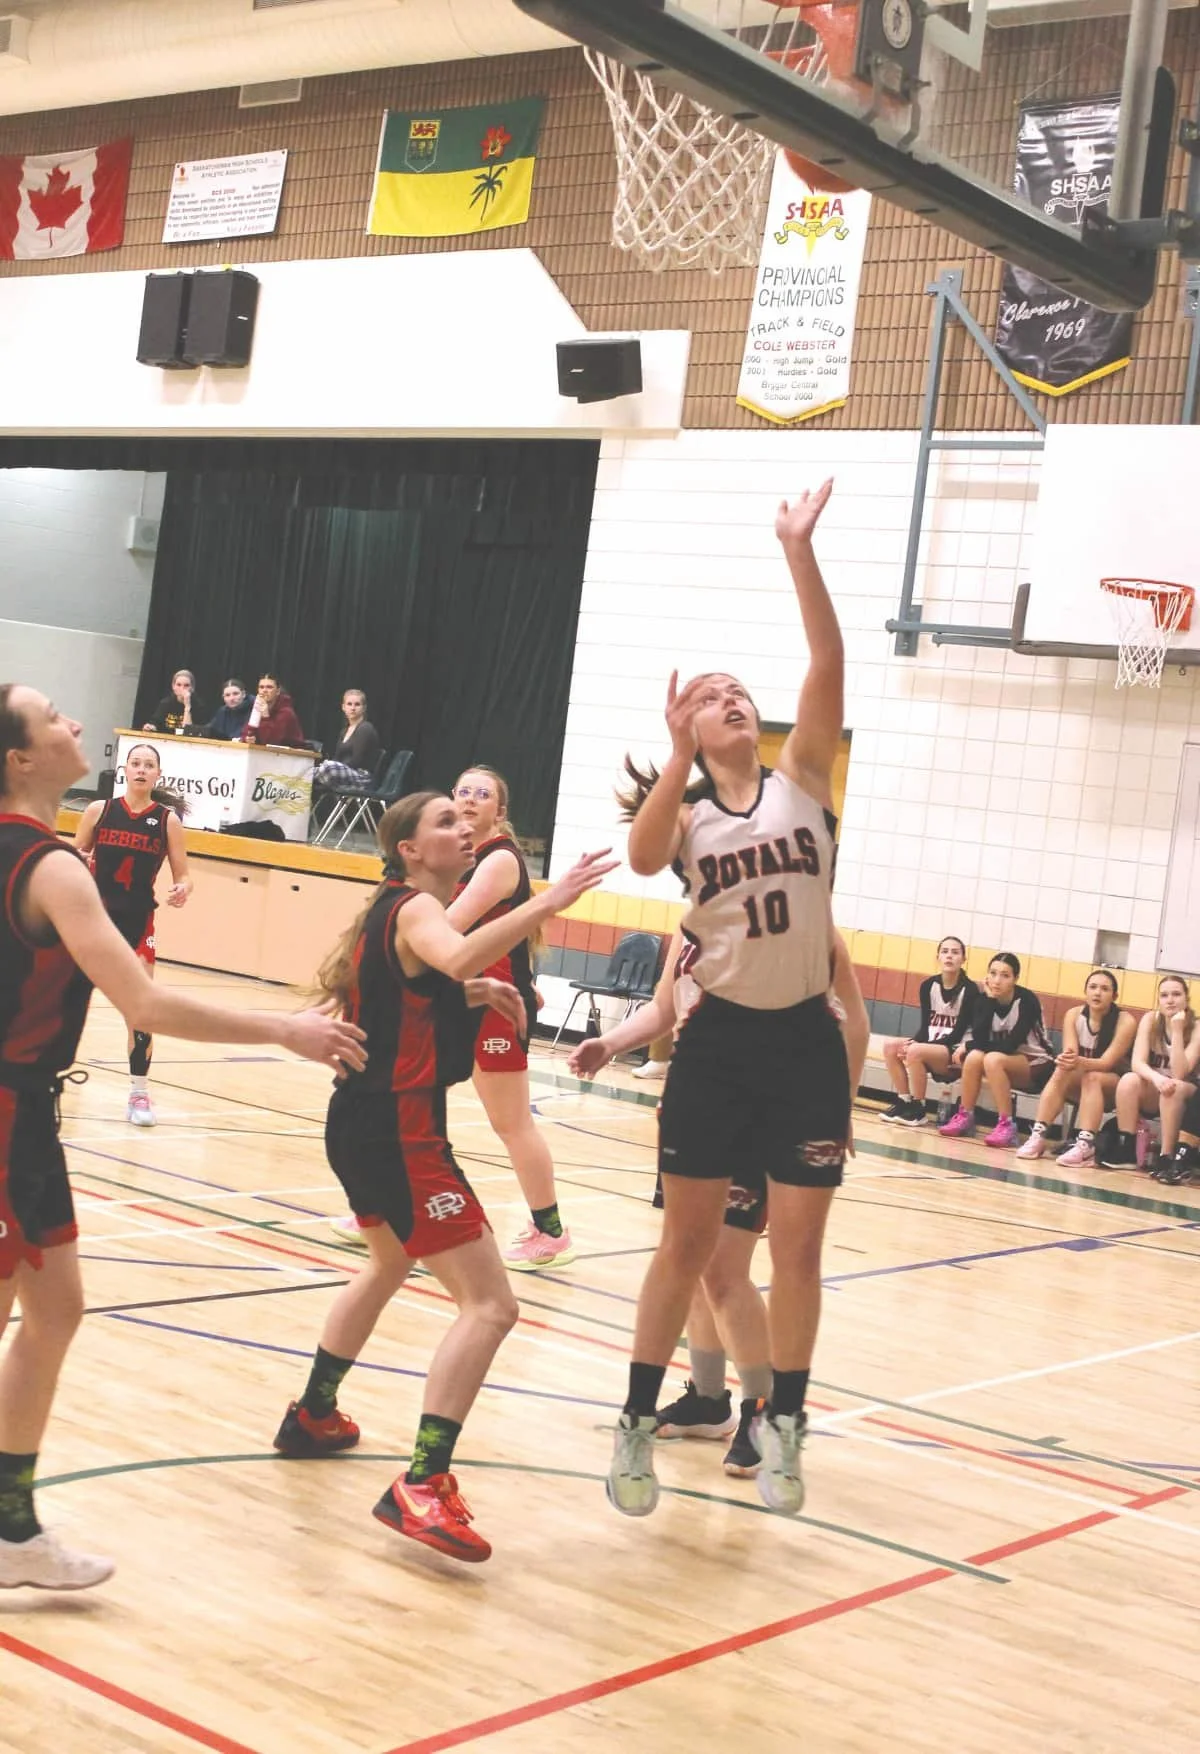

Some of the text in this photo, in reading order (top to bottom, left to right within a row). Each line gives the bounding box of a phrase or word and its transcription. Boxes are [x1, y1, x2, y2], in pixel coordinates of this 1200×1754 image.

[1050, 174, 1112, 196] SHSAA
[785, 198, 844, 220] SHSAA
[762, 265, 846, 286] PROVINCIAL
[758, 286, 845, 307] CHAMPIONS
[1001, 299, 1072, 325] Clarence
[751, 316, 845, 337] TRACK & FIELD
[1044, 318, 1086, 342] 1969
[753, 340, 836, 351] COLE WEBSTER
[825, 355, 848, 364] Gold
[816, 366, 838, 376] Gold
[207, 776, 236, 798] Go!
[98, 828, 160, 854] REBELS
[114, 855, 135, 891] 4
[697, 826, 821, 906] ROYALS
[743, 889, 790, 939] 10
